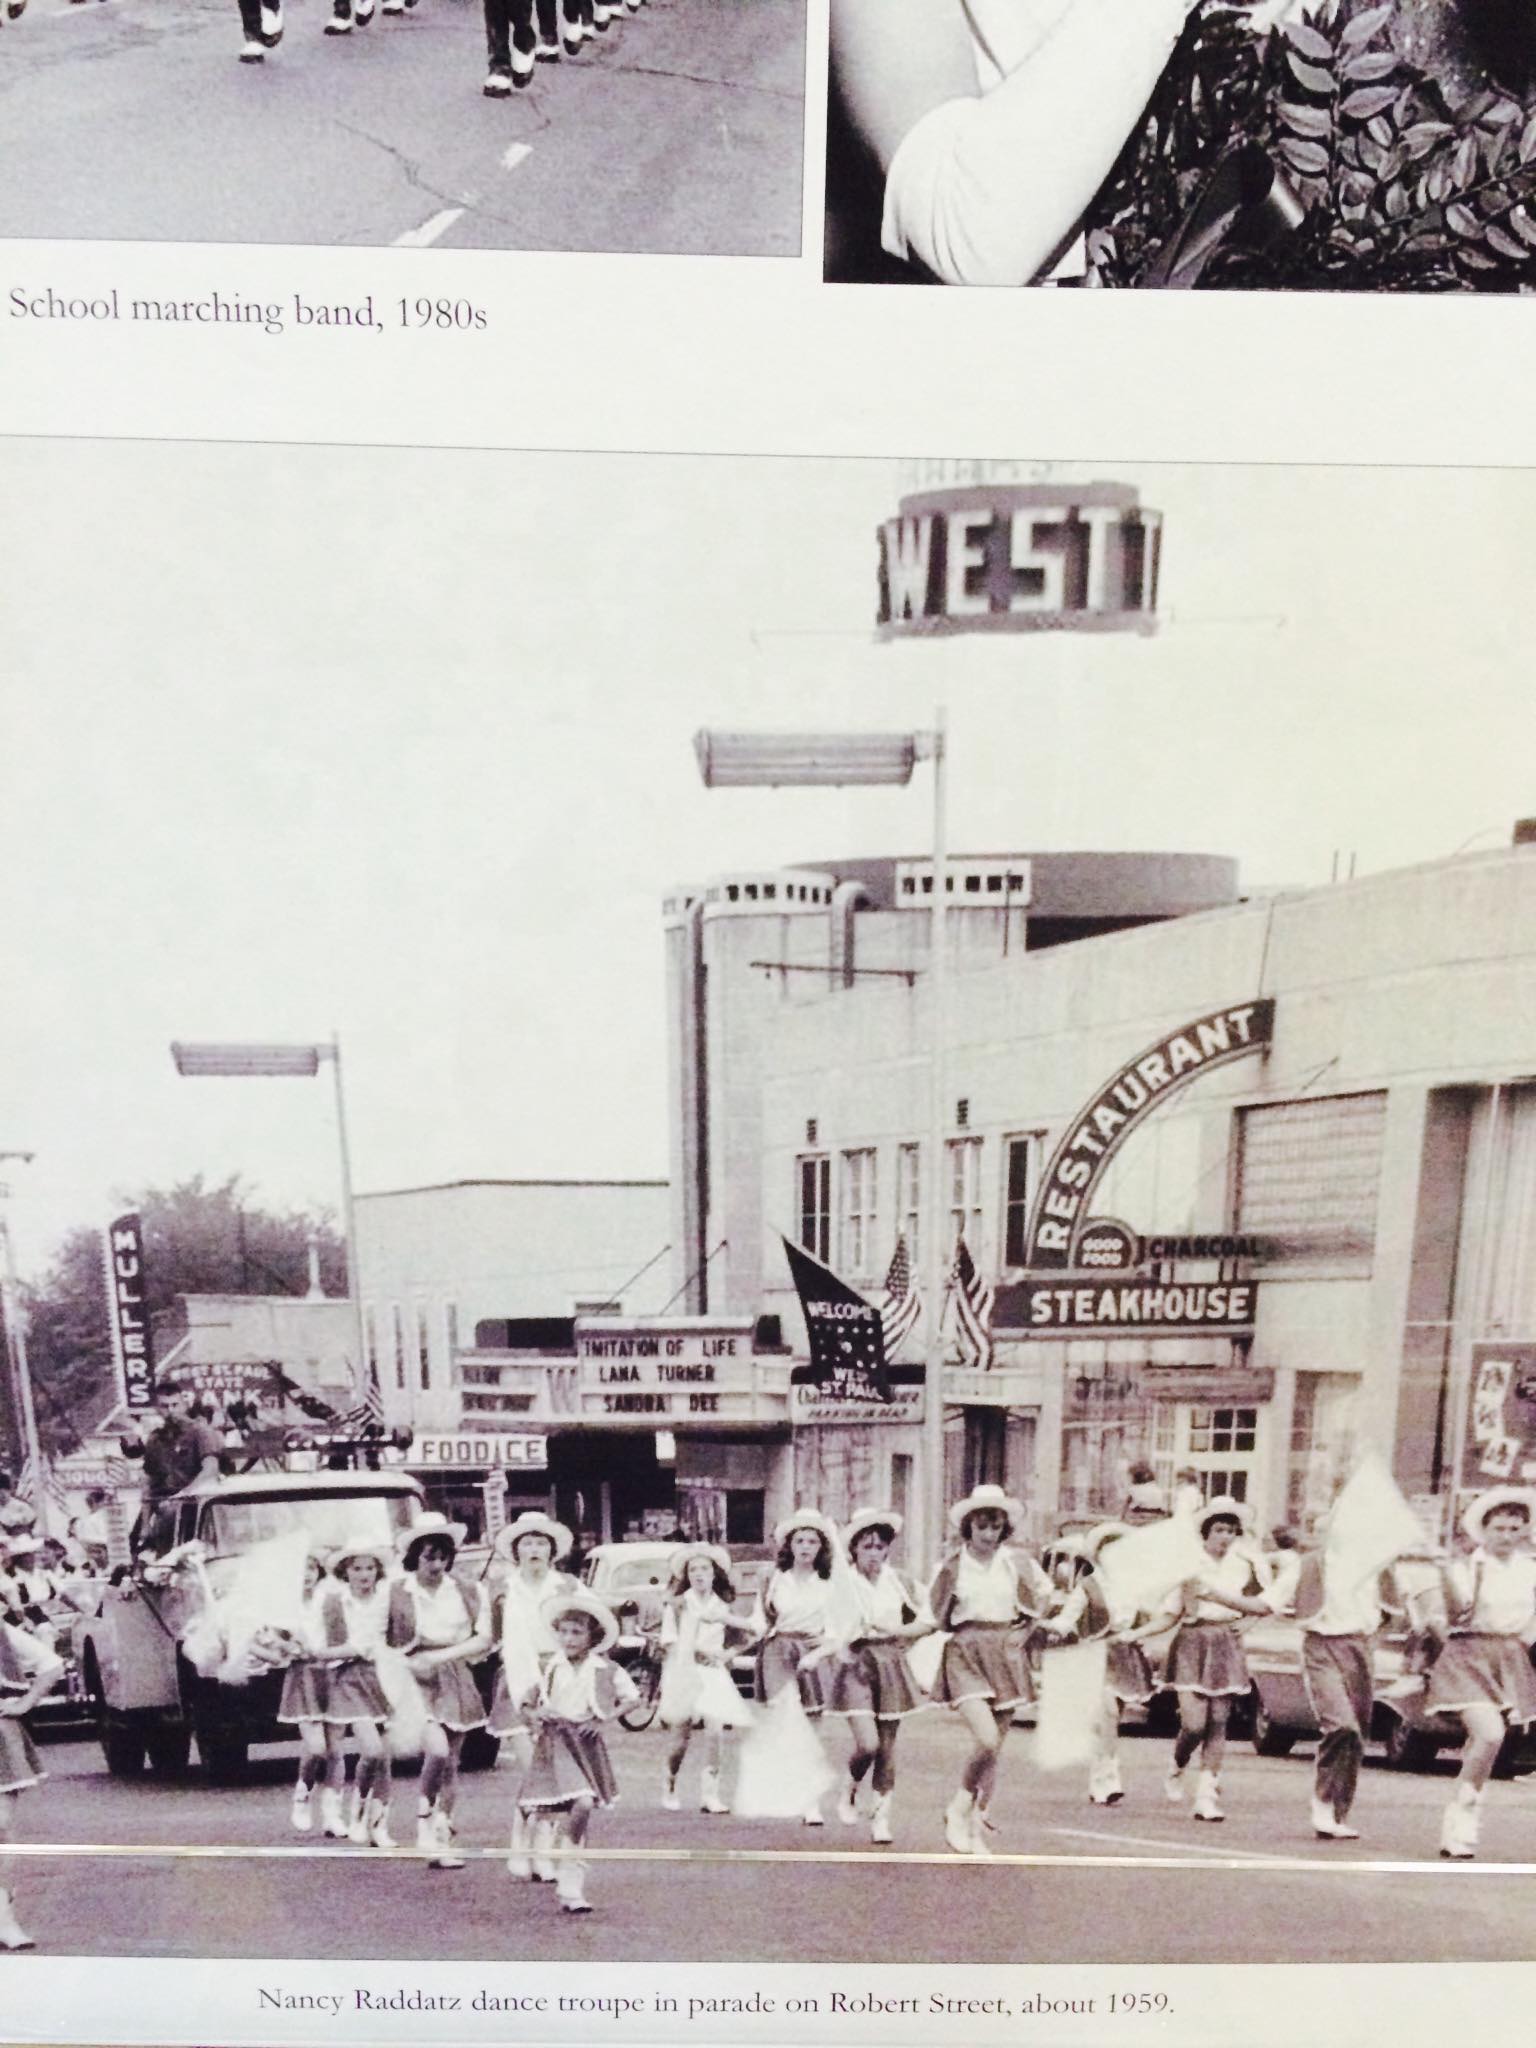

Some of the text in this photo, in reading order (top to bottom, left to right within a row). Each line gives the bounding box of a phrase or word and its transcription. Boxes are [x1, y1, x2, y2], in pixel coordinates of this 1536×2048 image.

[9, 287, 488, 335] School marching band, 1980s
[1038, 1007, 1255, 1250] RESTAURANT
[1149, 1237, 1260, 1259] CHARCOAL
[1081, 1252, 1122, 1266] FOOD
[806, 1301, 873, 1321] WELCOME
[1030, 1286, 1250, 1323] STEAKHOUSE
[583, 1338, 737, 1358] IMITATION OF LIFE
[599, 1364, 716, 1383] LANA TURNER
[603, 1393, 720, 1413] SANDRA DEE
[258, 1988, 1175, 2019] Nancy Raddatz dance troupe in parade on Robert Street, about 1959.
